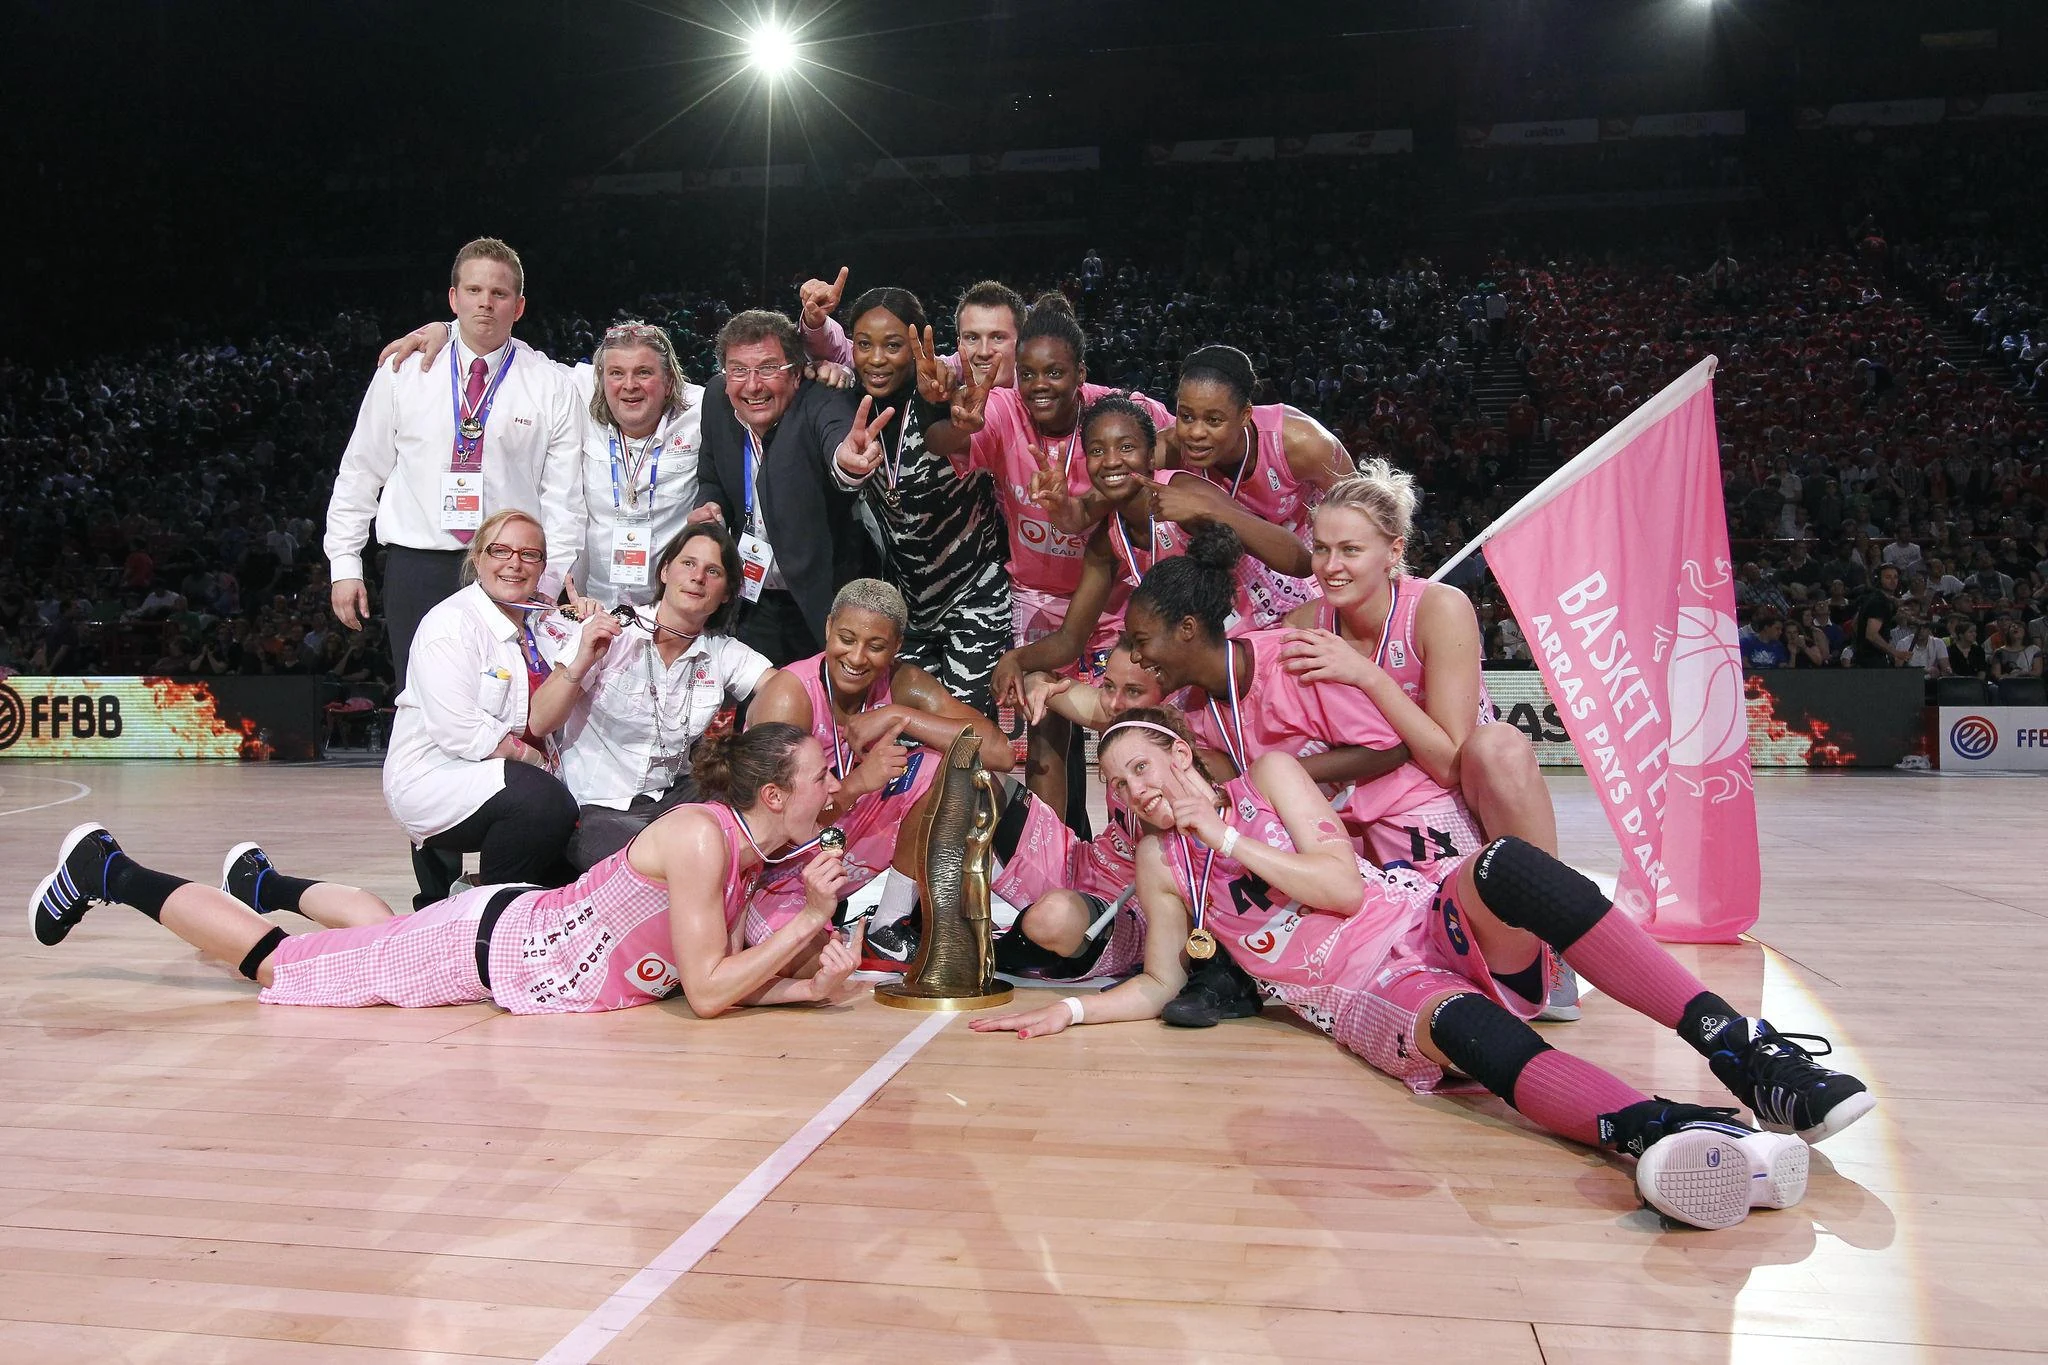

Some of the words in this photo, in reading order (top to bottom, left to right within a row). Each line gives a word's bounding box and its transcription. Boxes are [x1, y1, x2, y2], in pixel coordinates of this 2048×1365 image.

[31, 694, 122, 738] FFBB
[1531, 614, 1597, 720] ARRAS
[1585, 722, 1632, 805] PAYS
[1557, 569, 1662, 743] BASKET
